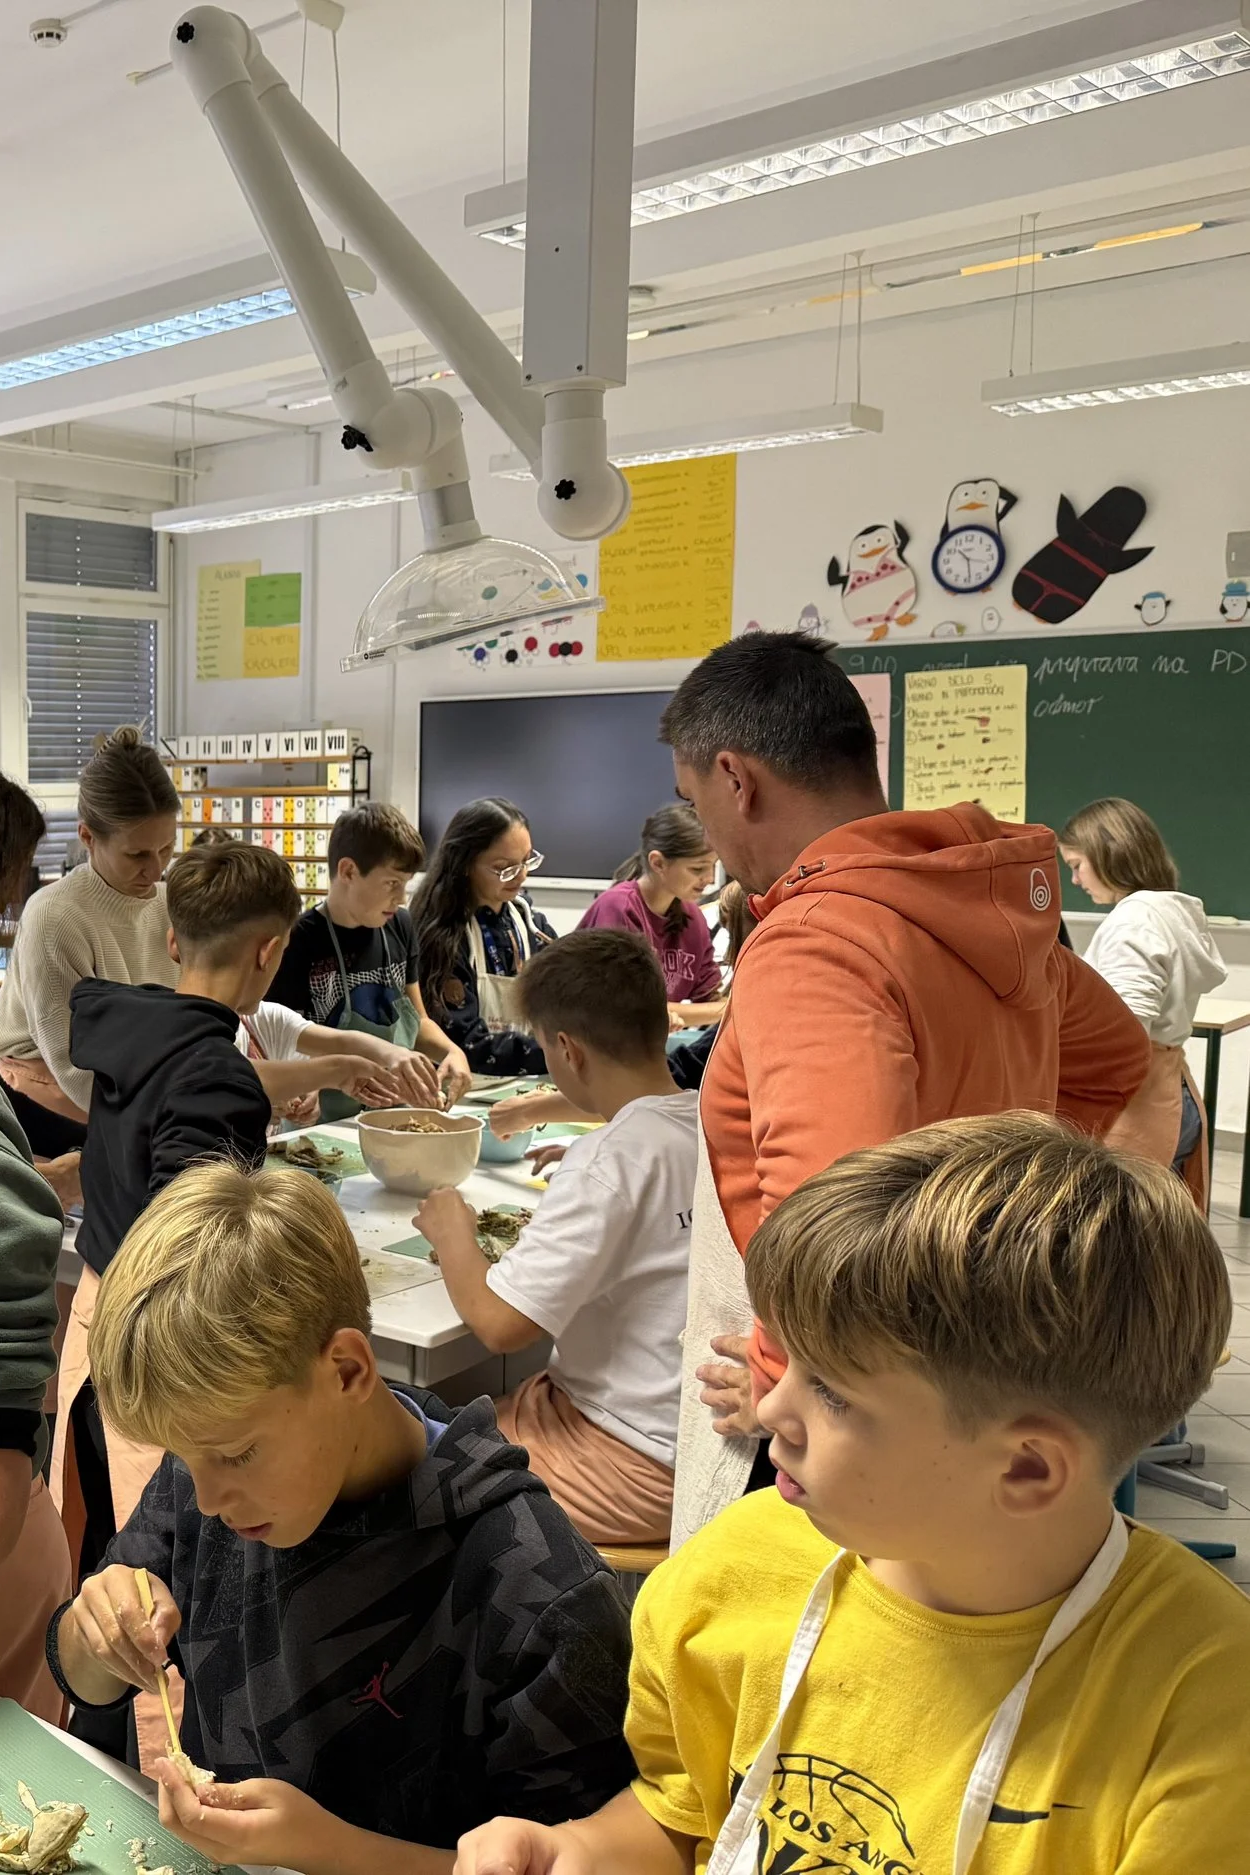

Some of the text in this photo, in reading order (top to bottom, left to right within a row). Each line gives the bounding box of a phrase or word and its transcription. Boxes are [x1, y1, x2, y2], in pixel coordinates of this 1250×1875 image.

[1211, 649, 1247, 674] PD
[203, 742, 211, 754] II
[222, 741, 232, 754] III
[243, 740, 252, 753] IV
[265, 739, 271, 752] V
[284, 738, 294, 751] VI
[304, 737, 317, 750] VII
[328, 735, 344, 749] VIII
[663, 949, 695, 980] OK
[769, 1798, 836, 1843] LOS
